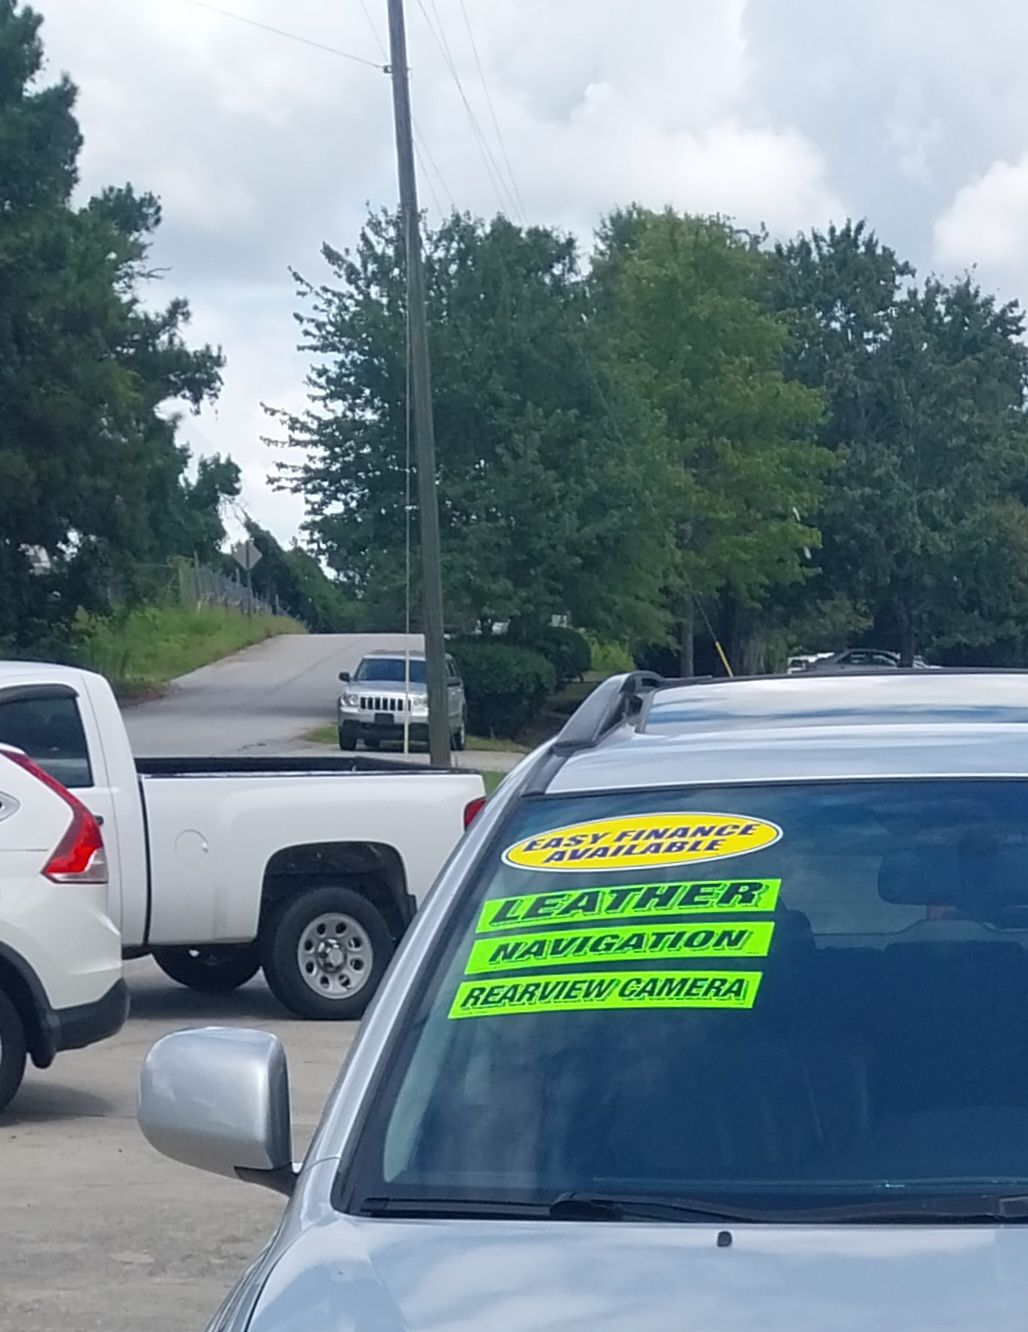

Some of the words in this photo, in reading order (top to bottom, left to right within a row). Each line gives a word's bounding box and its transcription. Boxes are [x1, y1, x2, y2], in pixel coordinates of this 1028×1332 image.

[523, 832, 608, 851] EASY
[615, 823, 760, 842] FINANCE
[543, 840, 727, 862] AVAILABLE
[489, 882, 769, 926] LEATHER
[488, 929, 753, 964] NAVIGATION
[460, 978, 620, 1010] REARVIEW
[618, 977, 750, 1003] CAMERA
